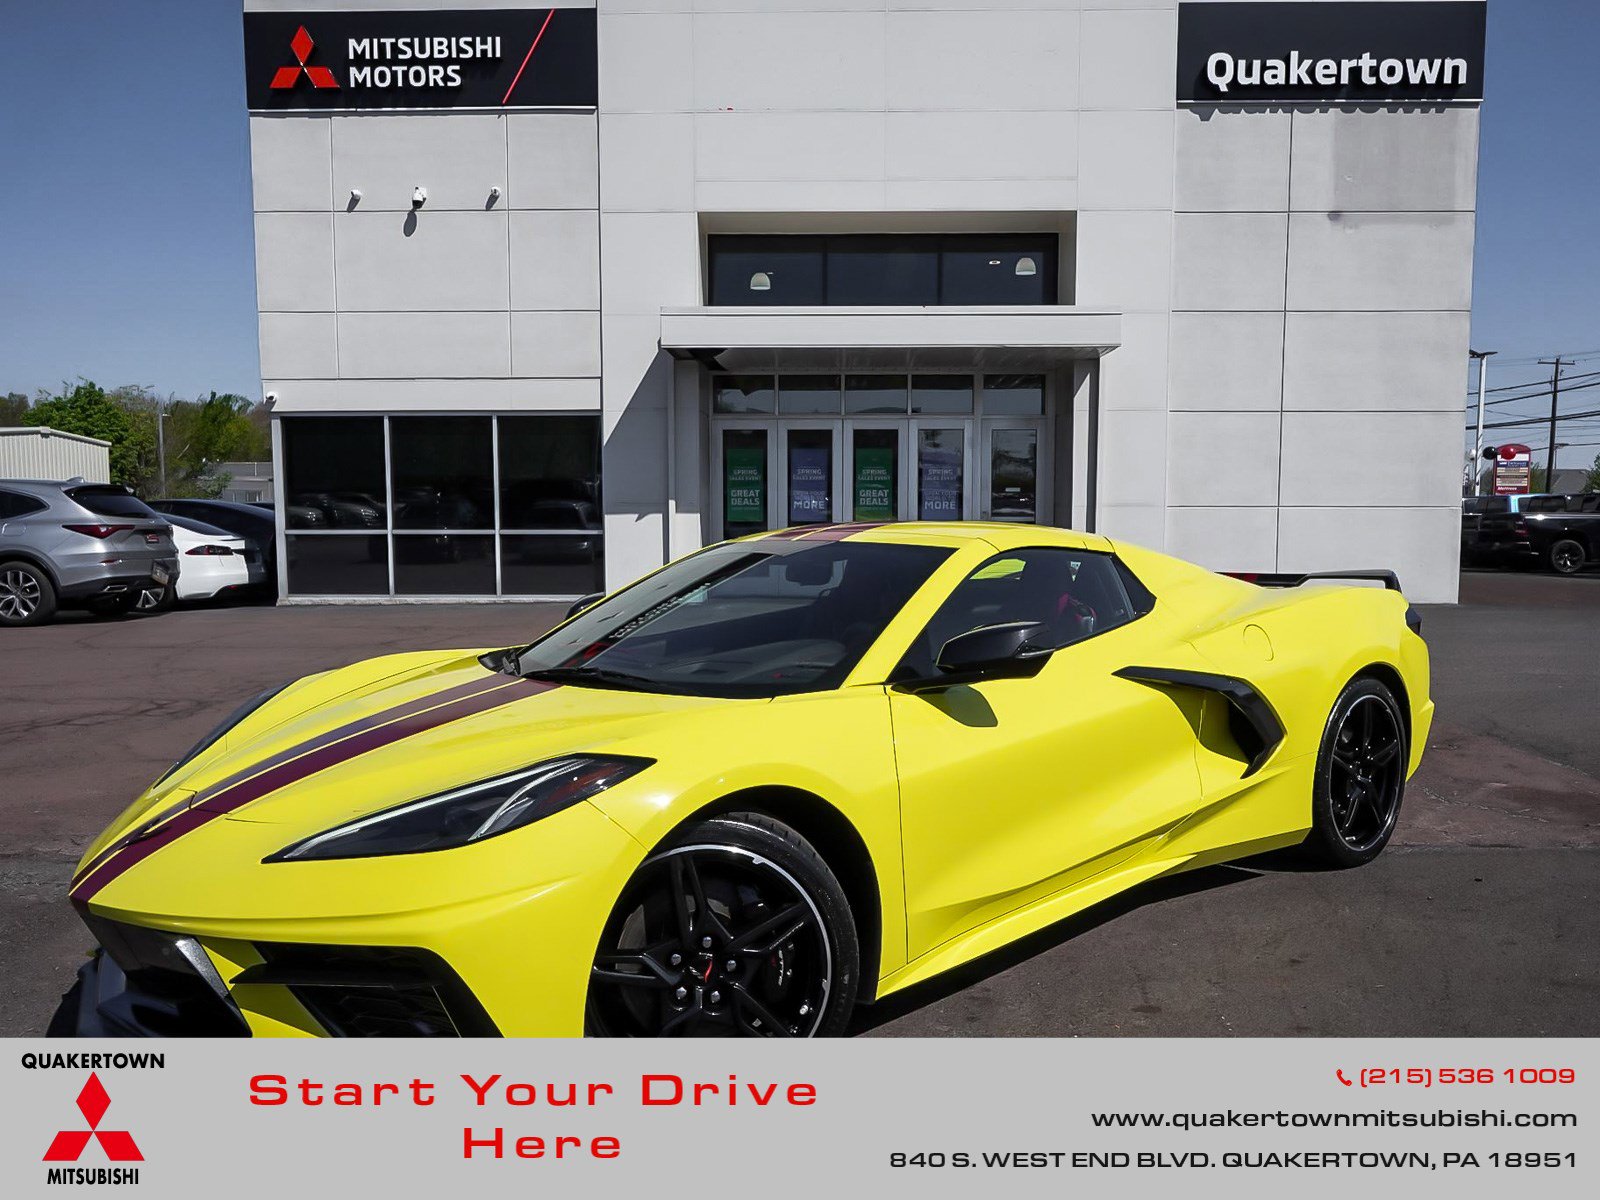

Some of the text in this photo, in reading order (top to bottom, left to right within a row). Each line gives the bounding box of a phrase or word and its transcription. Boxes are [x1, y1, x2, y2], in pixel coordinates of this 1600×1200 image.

[348, 36, 501, 60] MITSUBISHI
[1206, 50, 1468, 92] Quakertown
[350, 65, 462, 88] MOTORS
[731, 489, 760, 498] GREAT
[860, 489, 889, 498] GREAT
[731, 498, 760, 506] DEALS
[793, 501, 825, 510] MORE
[860, 498, 889, 506] DEALS
[924, 501, 956, 510] MORE
